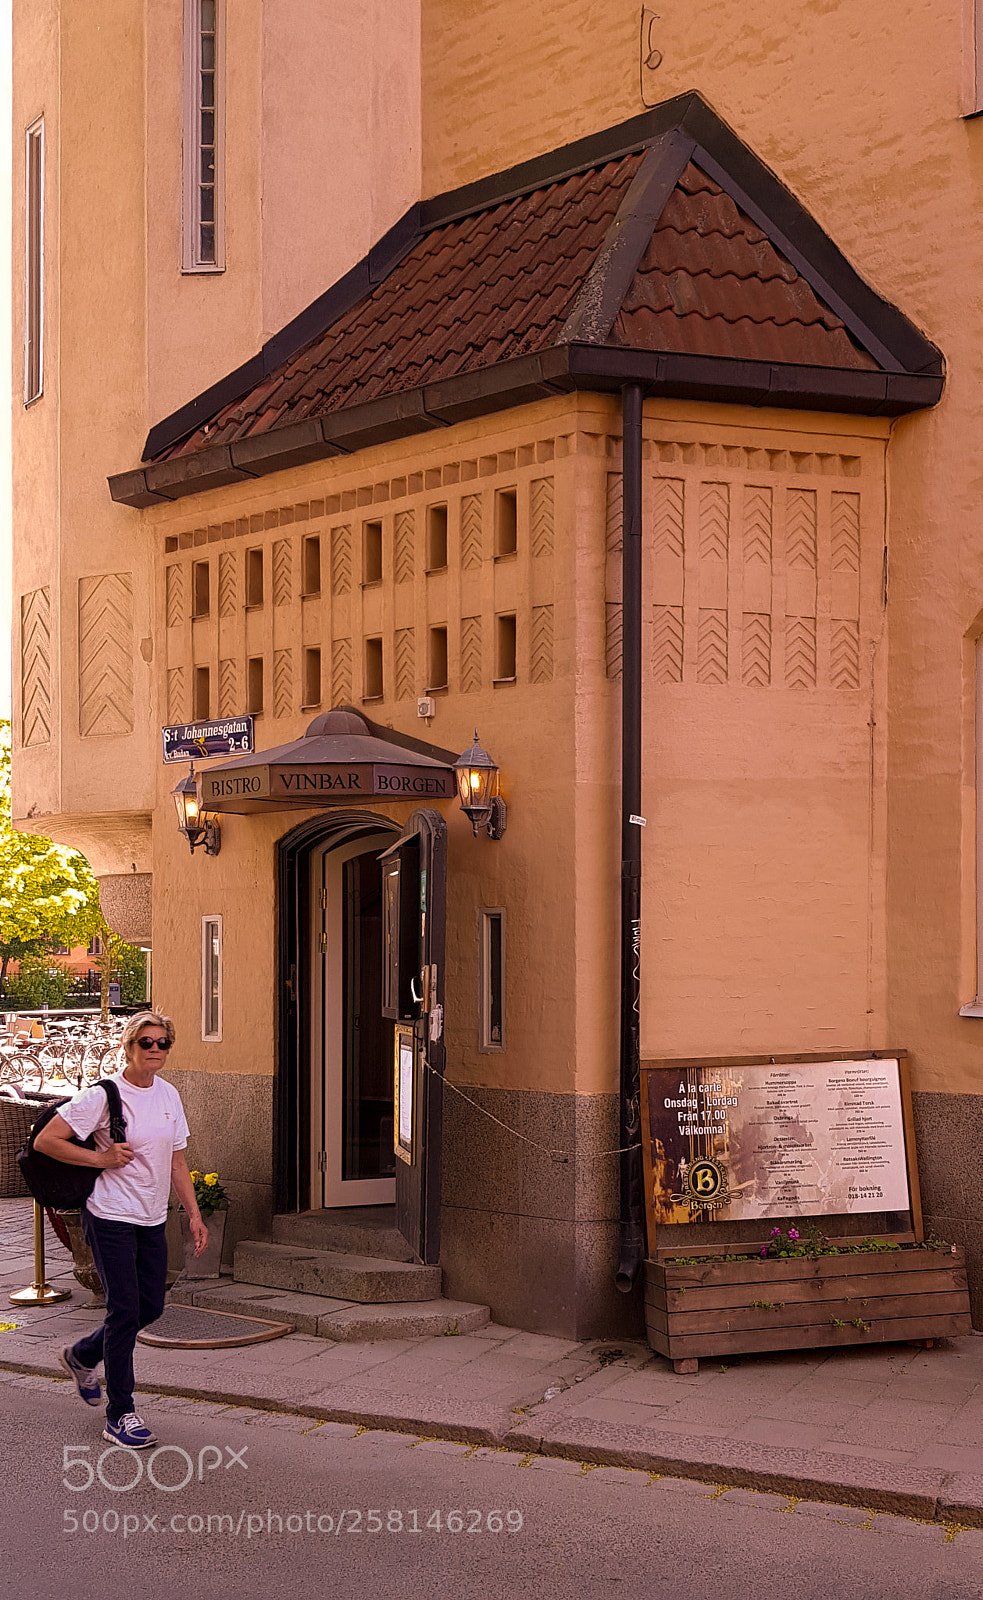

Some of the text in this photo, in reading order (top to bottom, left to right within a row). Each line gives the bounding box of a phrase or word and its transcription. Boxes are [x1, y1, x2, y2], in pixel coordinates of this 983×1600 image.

[164, 722, 247, 742] S:t Johannesgatan
[228, 735, 249, 752] 2-6
[211, 776, 262, 797] BISTRO
[280, 773, 362, 790] VINBAR
[378, 775, 446, 793] BORGEN
[687, 1083, 696, 1093] la
[698, 1082, 722, 1093] carte
[664, 1097, 698, 1109] Onsdag
[677, 1109, 726, 1122] Från 17.00
[678, 1124, 726, 1136] Välkomna!
[695, 1168, 715, 1192] B
[690, 1200, 723, 1211] Borgen
